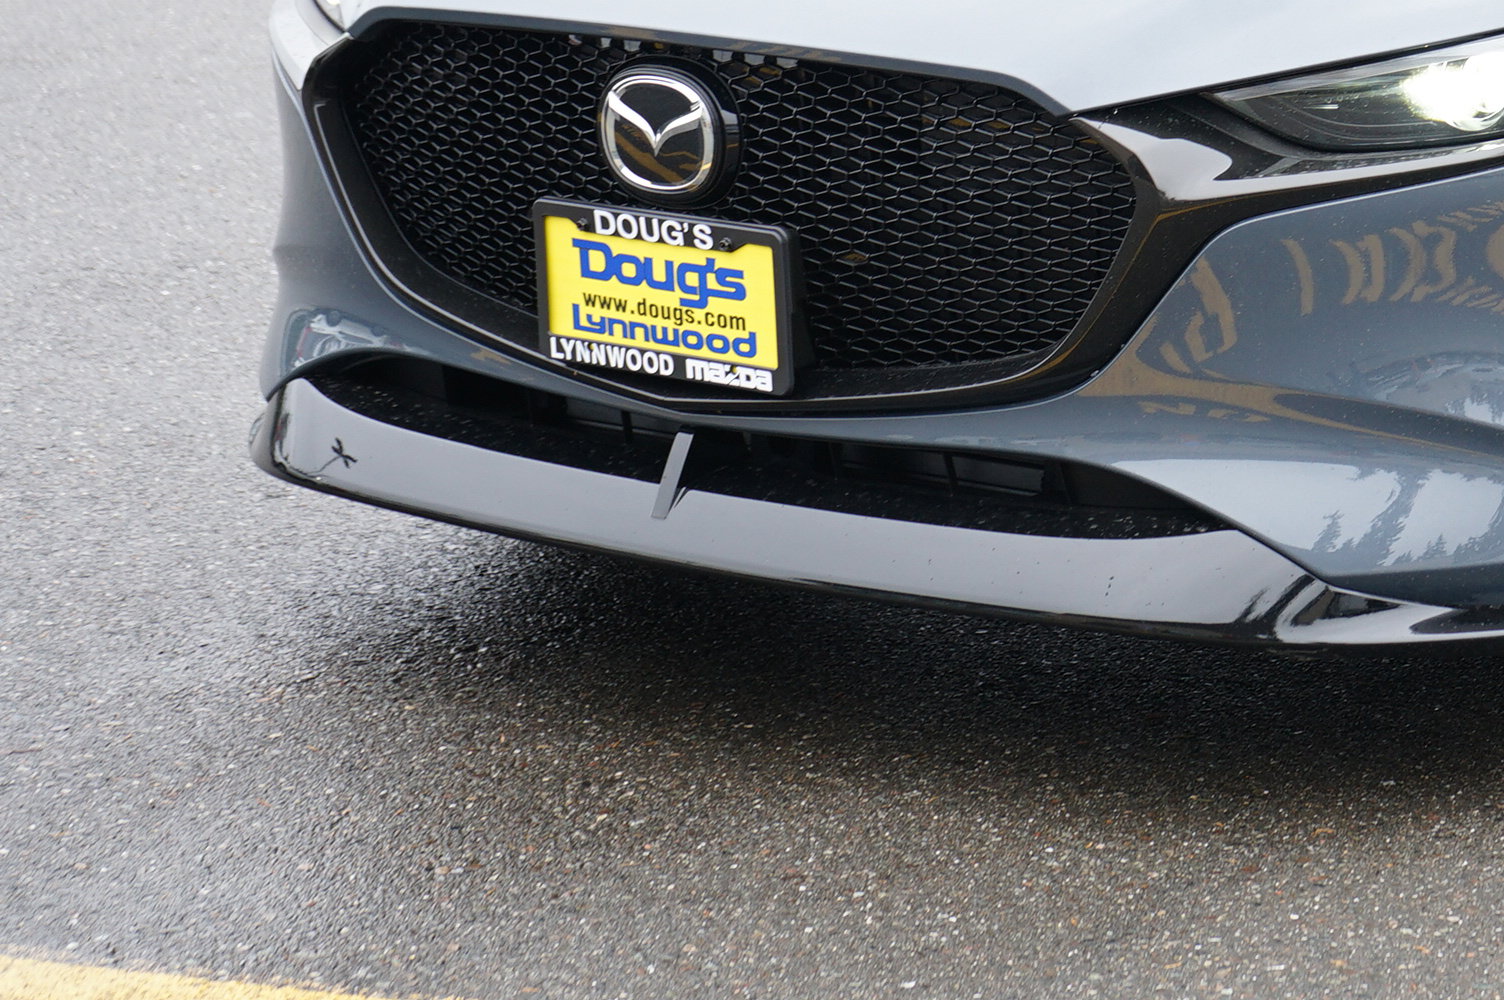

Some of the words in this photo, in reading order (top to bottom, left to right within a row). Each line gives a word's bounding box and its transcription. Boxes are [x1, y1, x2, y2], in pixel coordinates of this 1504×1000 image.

[593, 209, 714, 250] DOUG'S
[572, 303, 757, 358] Lynnwood
[583, 291, 746, 332] www.dougs.com
[549, 336, 675, 377] LYNNWOOD
